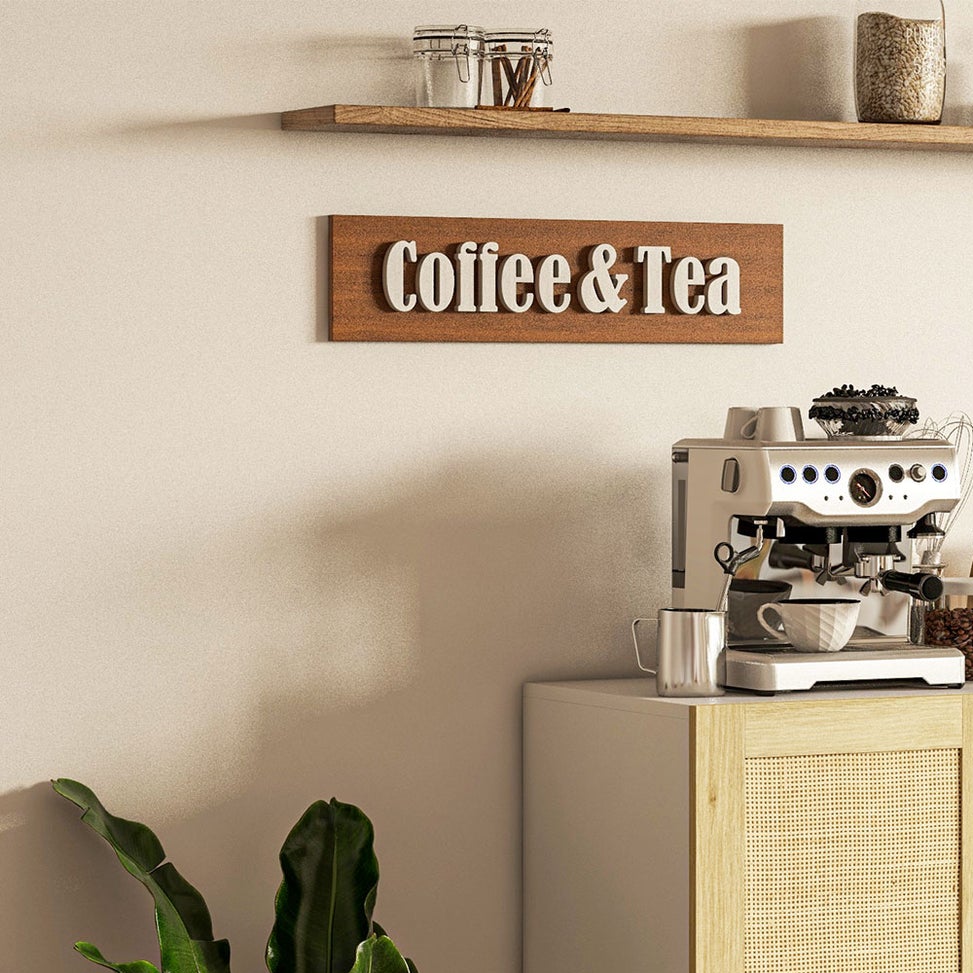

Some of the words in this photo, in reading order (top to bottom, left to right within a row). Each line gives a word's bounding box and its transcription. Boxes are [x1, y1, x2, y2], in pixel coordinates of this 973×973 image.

[383, 240, 572, 313] Coffee
[578, 243, 629, 314] &
[634, 246, 742, 315] Tea
